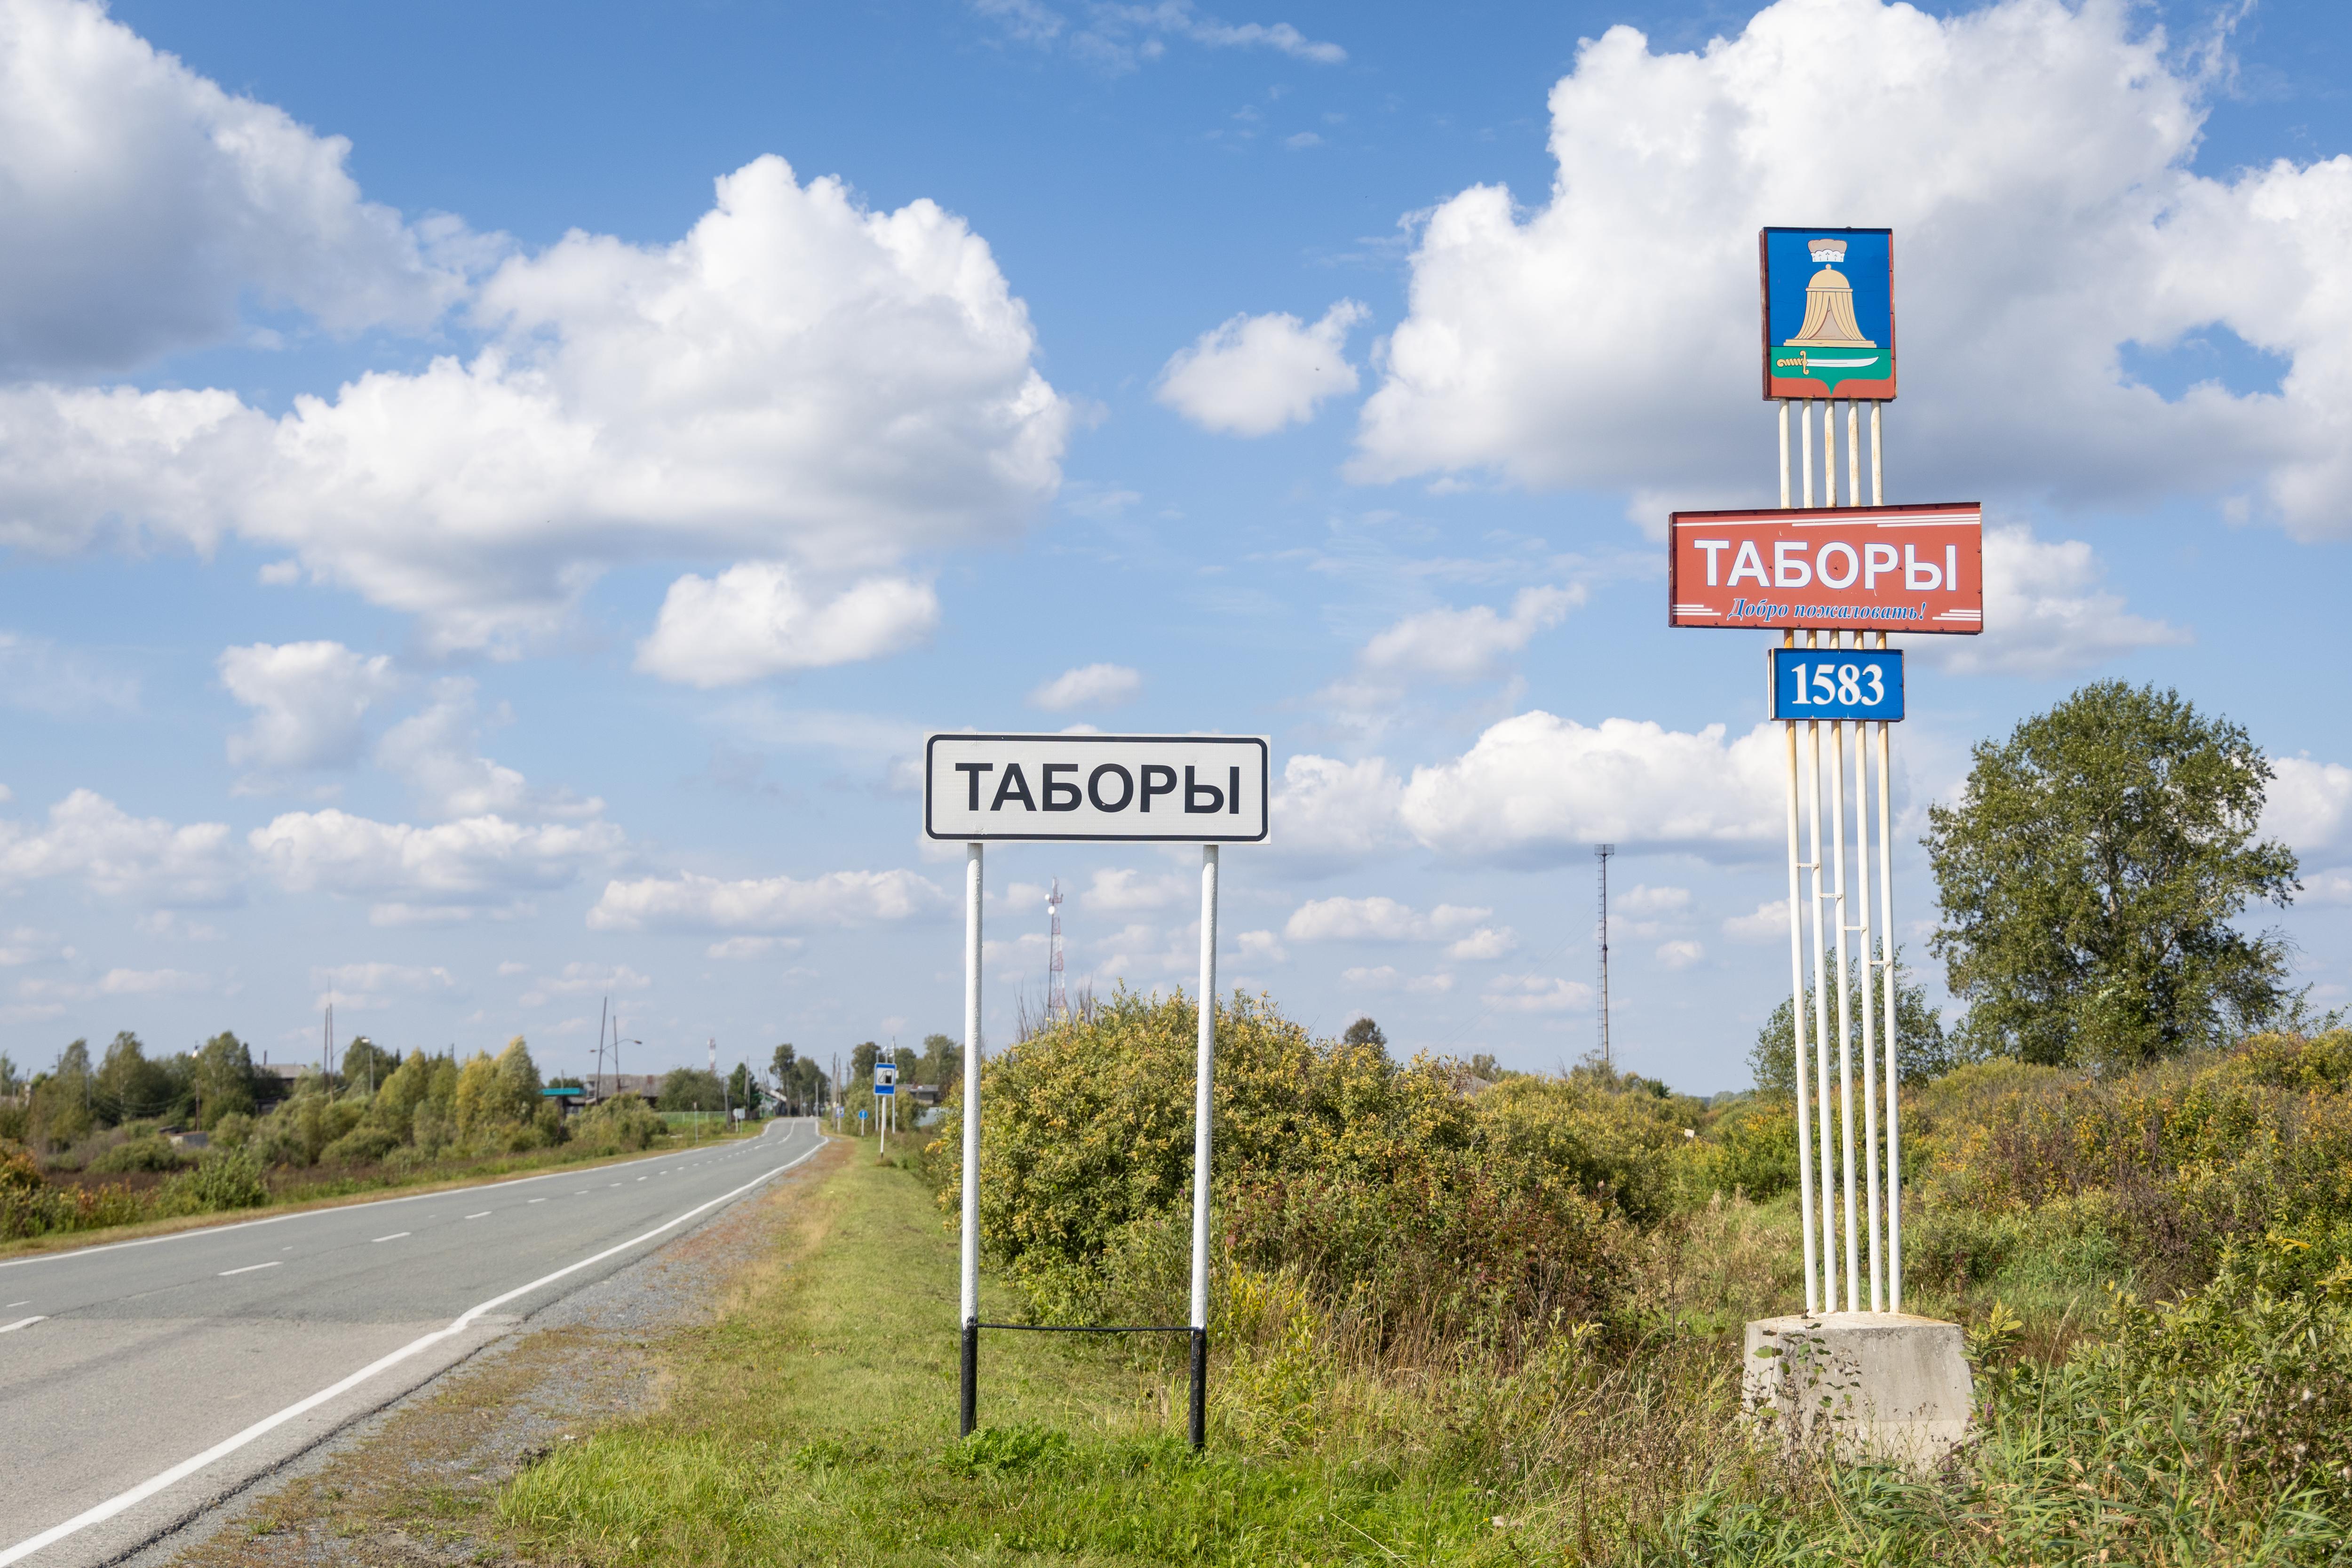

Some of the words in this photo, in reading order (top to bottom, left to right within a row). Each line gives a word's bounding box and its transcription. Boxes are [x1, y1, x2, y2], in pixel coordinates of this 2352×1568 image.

[1693, 540, 1957, 591] ТАБОРЫ
[1727, 598, 1788, 622] Добро
[1794, 602, 1927, 621] пожаловать!
[1792, 663, 1883, 706] 1583
[955, 763, 1240, 814] ТАБОРЫ
